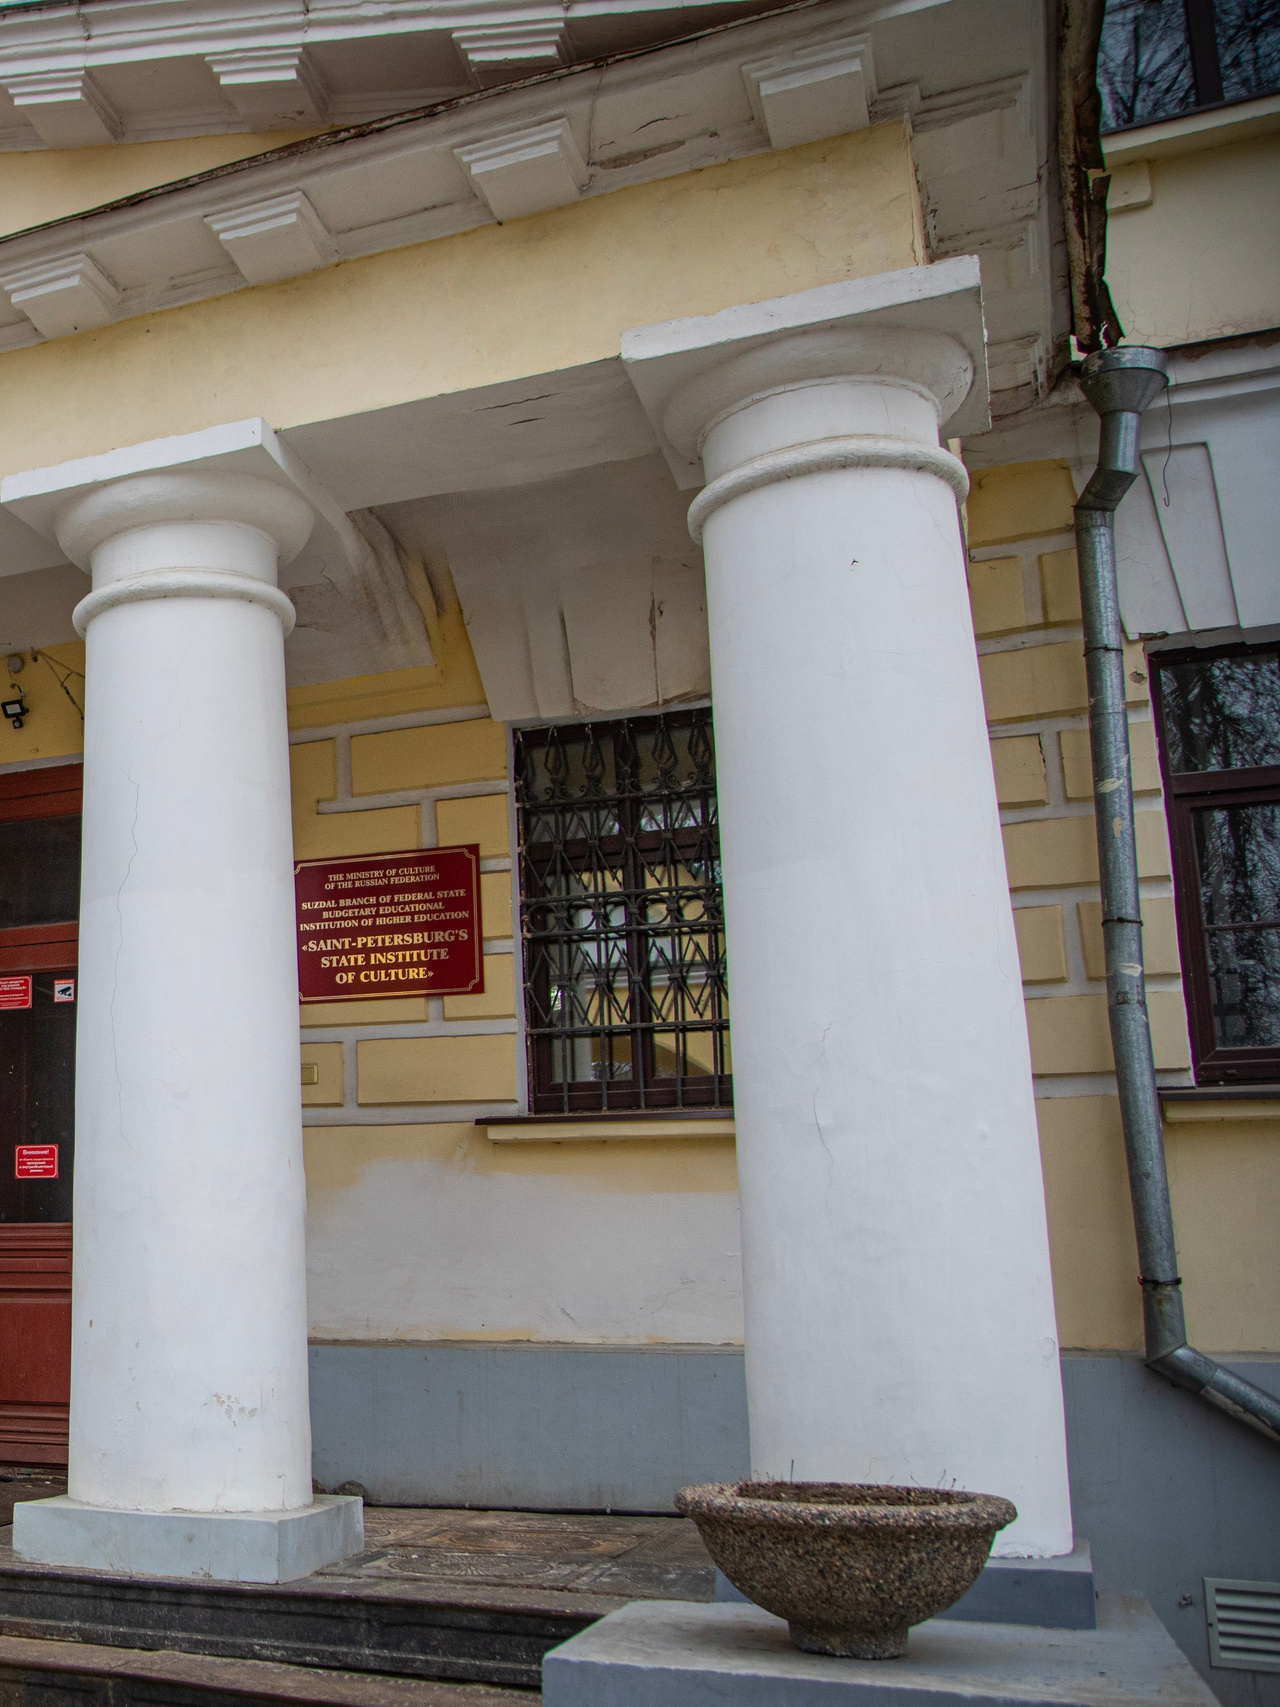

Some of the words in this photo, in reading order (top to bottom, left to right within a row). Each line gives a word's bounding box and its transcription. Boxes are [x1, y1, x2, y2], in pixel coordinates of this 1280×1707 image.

[337, 881, 353, 889] THE
[355, 878, 388, 888] RUSSIAN
[390, 874, 440, 885] FEDERATION
[346, 870, 384, 880] MINISTRY
[399, 866, 435, 875] CULTURE
[302, 901, 337, 910] SUZDAL
[339, 897, 376, 907] BRANCH
[379, 895, 392, 903] OF
[394, 892, 434, 902] FEDERAL
[437, 889, 466, 898] STATE
[322, 907, 377, 919] BUDGETARY
[379, 902, 444, 914] EDUCATIONAL
[300, 918, 358, 931] INSTITUTION
[361, 918, 373, 926] OF
[376, 915, 412, 925] HIGHER
[414, 911, 469, 922] EDUCATION
[302, 929, 468, 952] «SAINT-PETERSBURG'S
[321, 954, 365, 968] STATE
[370, 948, 449, 965] INSTITUTE
[335, 972, 355, 984] OF
[360, 967, 433, 982] CULTURE»
